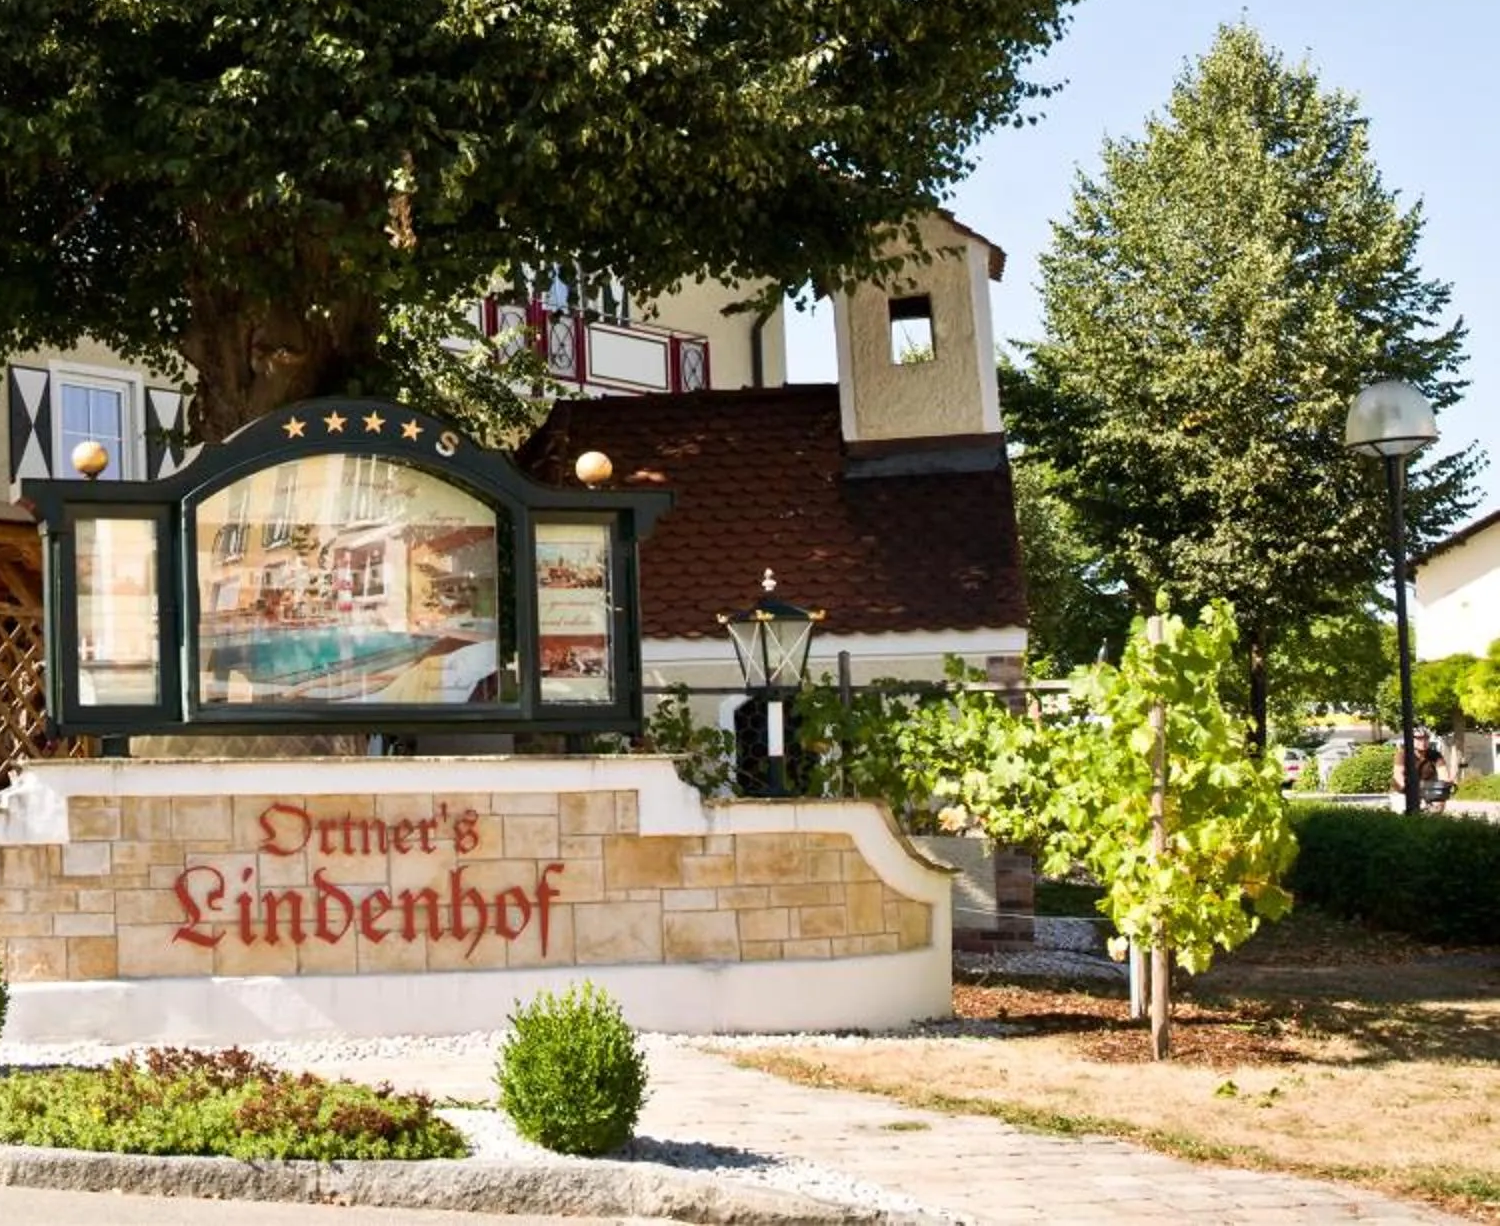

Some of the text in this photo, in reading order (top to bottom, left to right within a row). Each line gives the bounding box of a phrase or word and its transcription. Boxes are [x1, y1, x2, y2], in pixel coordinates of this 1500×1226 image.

[435, 430, 460, 457] S
[258, 801, 480, 857] Ortner's
[171, 863, 565, 960] Lindenhof
